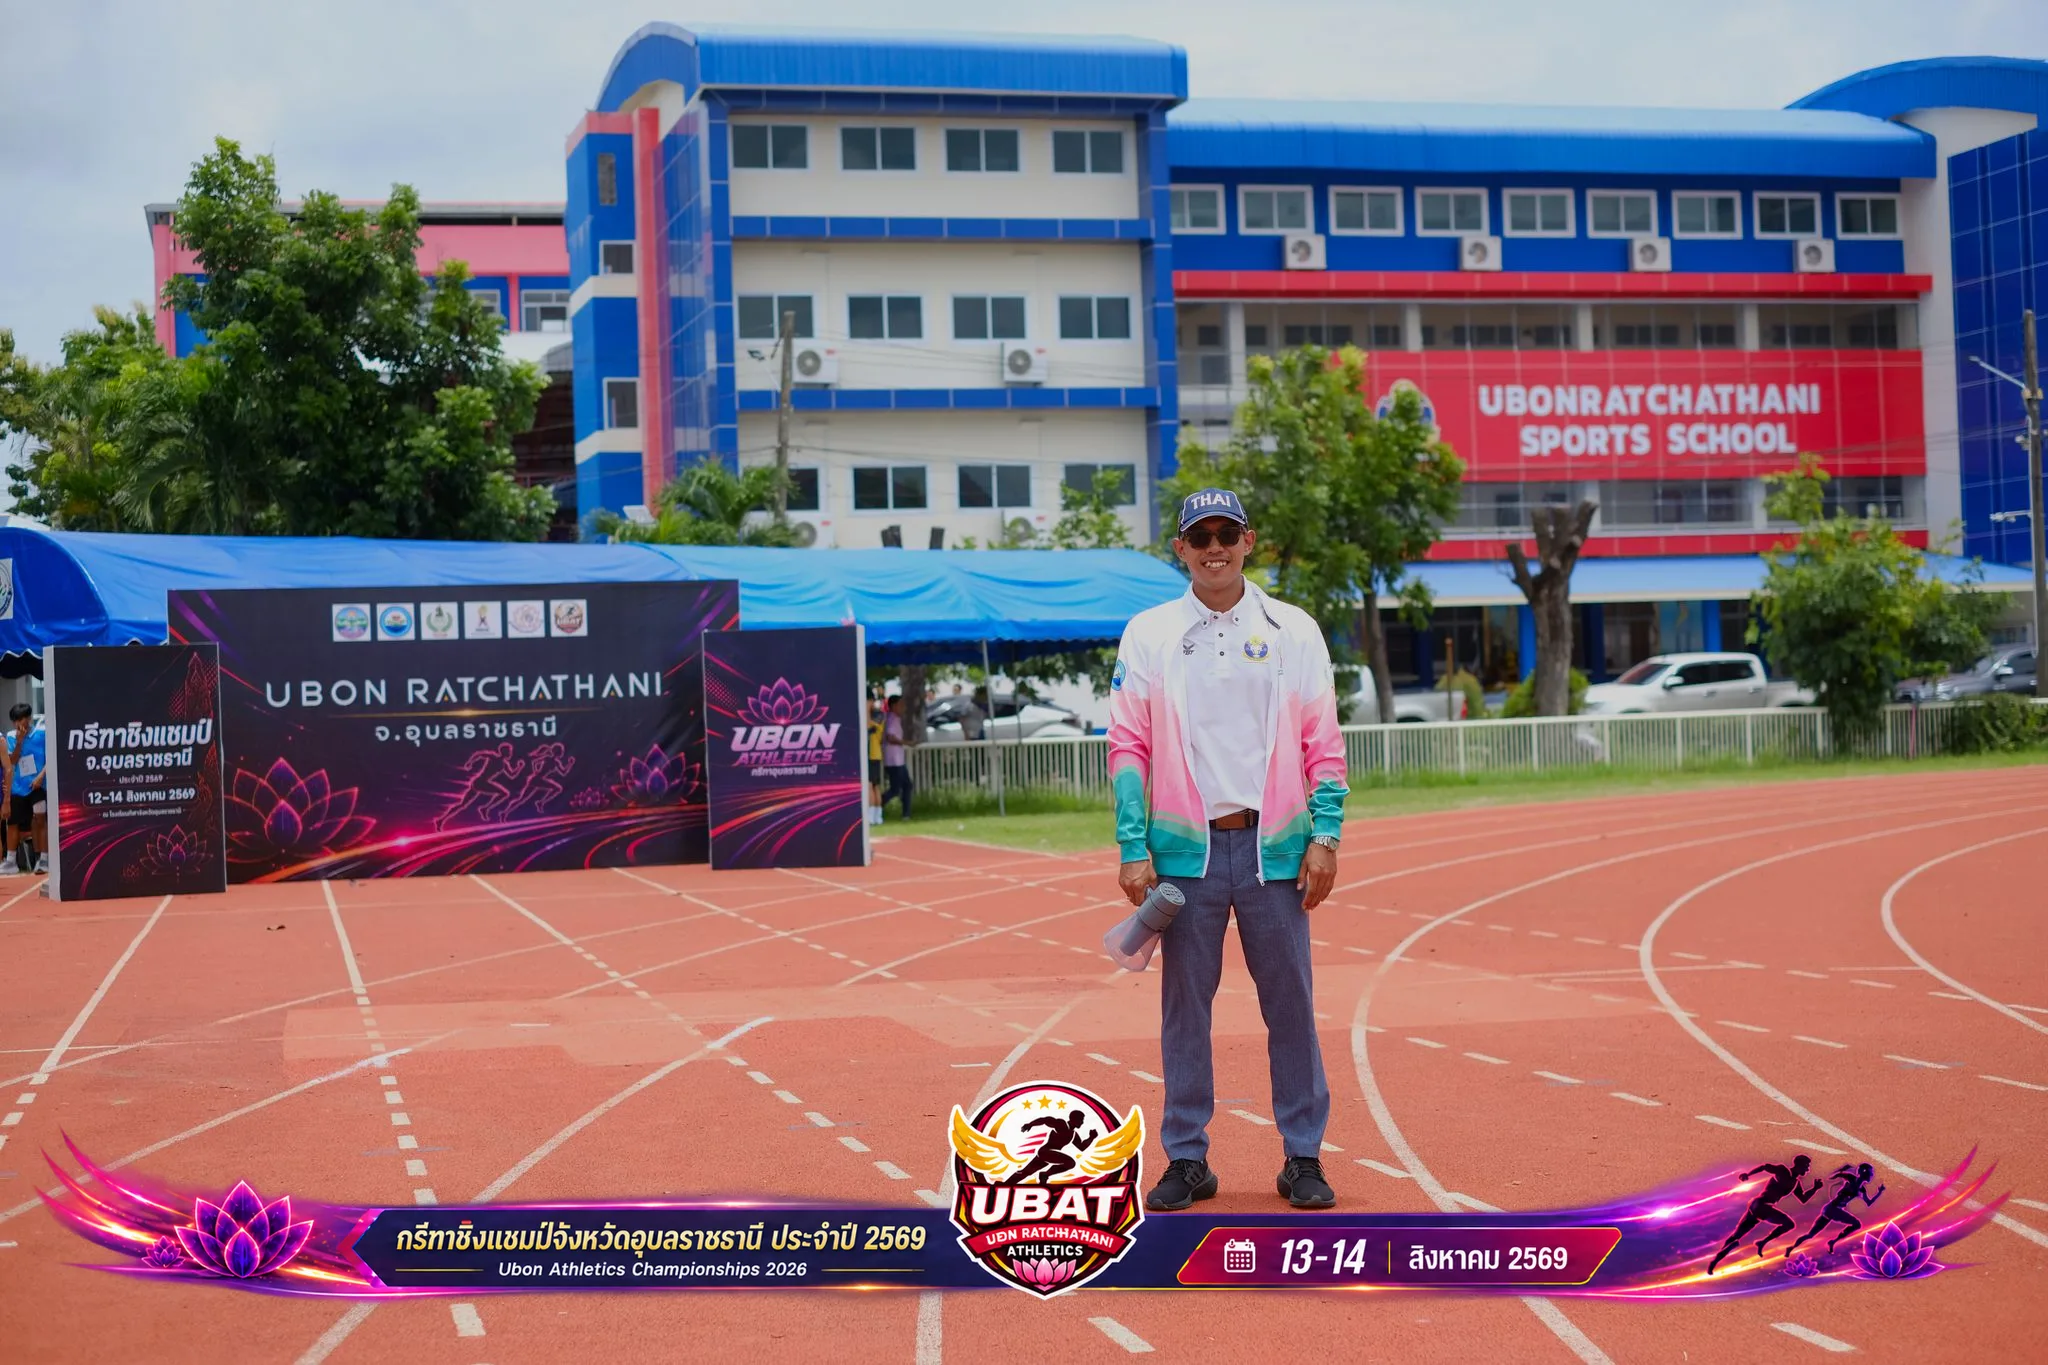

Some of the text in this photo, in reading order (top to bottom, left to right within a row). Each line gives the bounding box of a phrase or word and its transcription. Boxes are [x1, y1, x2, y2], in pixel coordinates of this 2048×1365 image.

[1478, 384, 1820, 417] UBONRATCHATHANI
[1520, 422, 1797, 456] SPORTS SCHOOL
[1191, 493, 1231, 510] THAI
[266, 671, 662, 707] UBON RATCHATHANI
[68, 718, 213, 750] กรีฑาชิงแชมป์
[375, 715, 557, 747] จ.อุบลราชธานี
[730, 723, 841, 752] UBON
[86, 747, 193, 775] จ.อุบลราชธานี
[735, 749, 836, 765] ATHLETICS
[145, 774, 163, 783] 2569
[126, 789, 165, 802] สิงหาคม
[169, 788, 195, 800] 2569
